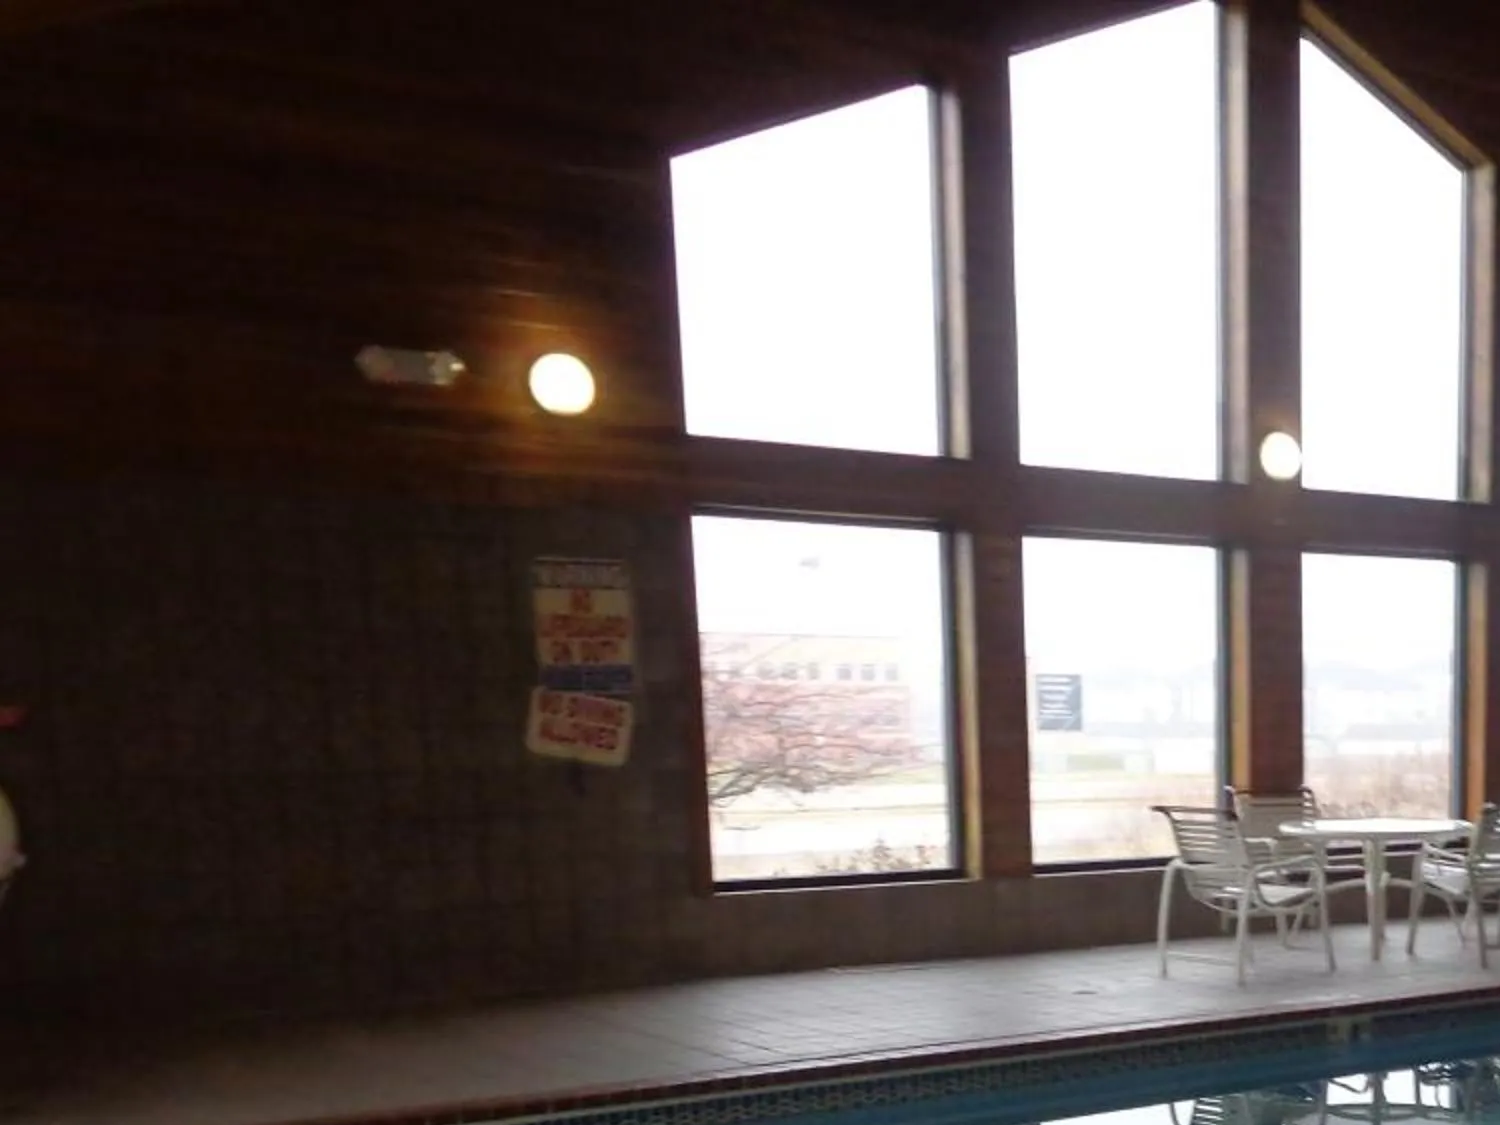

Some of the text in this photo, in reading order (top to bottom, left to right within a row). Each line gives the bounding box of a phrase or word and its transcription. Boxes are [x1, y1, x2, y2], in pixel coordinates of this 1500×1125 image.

[571, 588, 592, 613] NO
[537, 614, 630, 638] LIFEGUARD
[551, 638, 619, 663] ON DUTY
[537, 693, 626, 728] NO DIVING
[537, 717, 619, 751] ALLOWED
